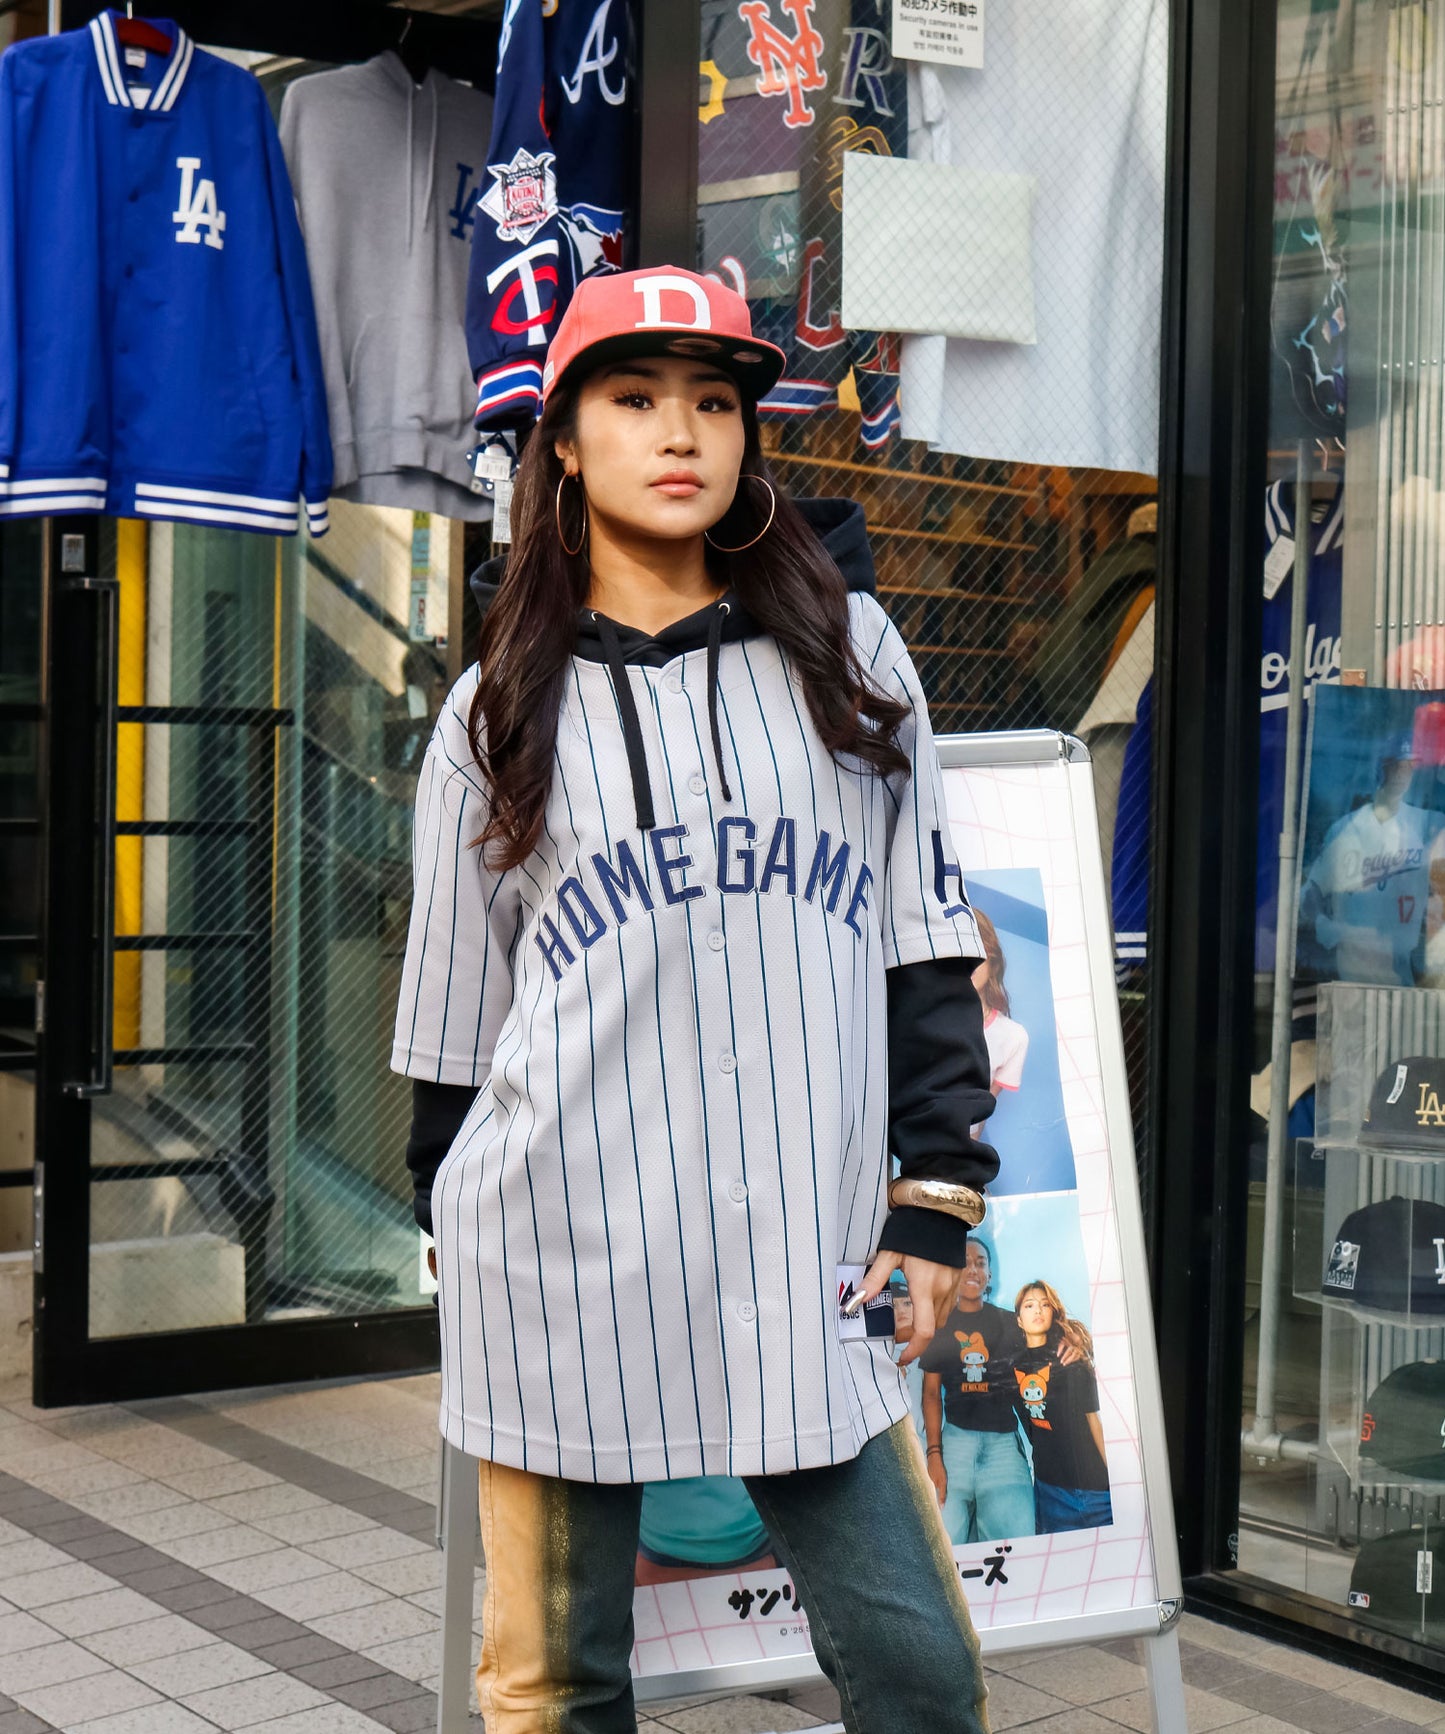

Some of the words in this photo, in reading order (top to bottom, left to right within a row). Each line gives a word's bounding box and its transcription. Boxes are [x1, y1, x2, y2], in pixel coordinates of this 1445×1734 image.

[561, 0, 625, 104] A
[899, 13, 927, 26] Security
[928, 18, 957, 29] cameras
[958, 21, 965, 29] in
[966, 24, 978, 32] use
[172, 156, 226, 250] LA
[633, 275, 711, 330] D
[534, 823, 706, 984] HOME
[716, 816, 874, 940] GAME
[1397, 895, 1415, 924] 17
